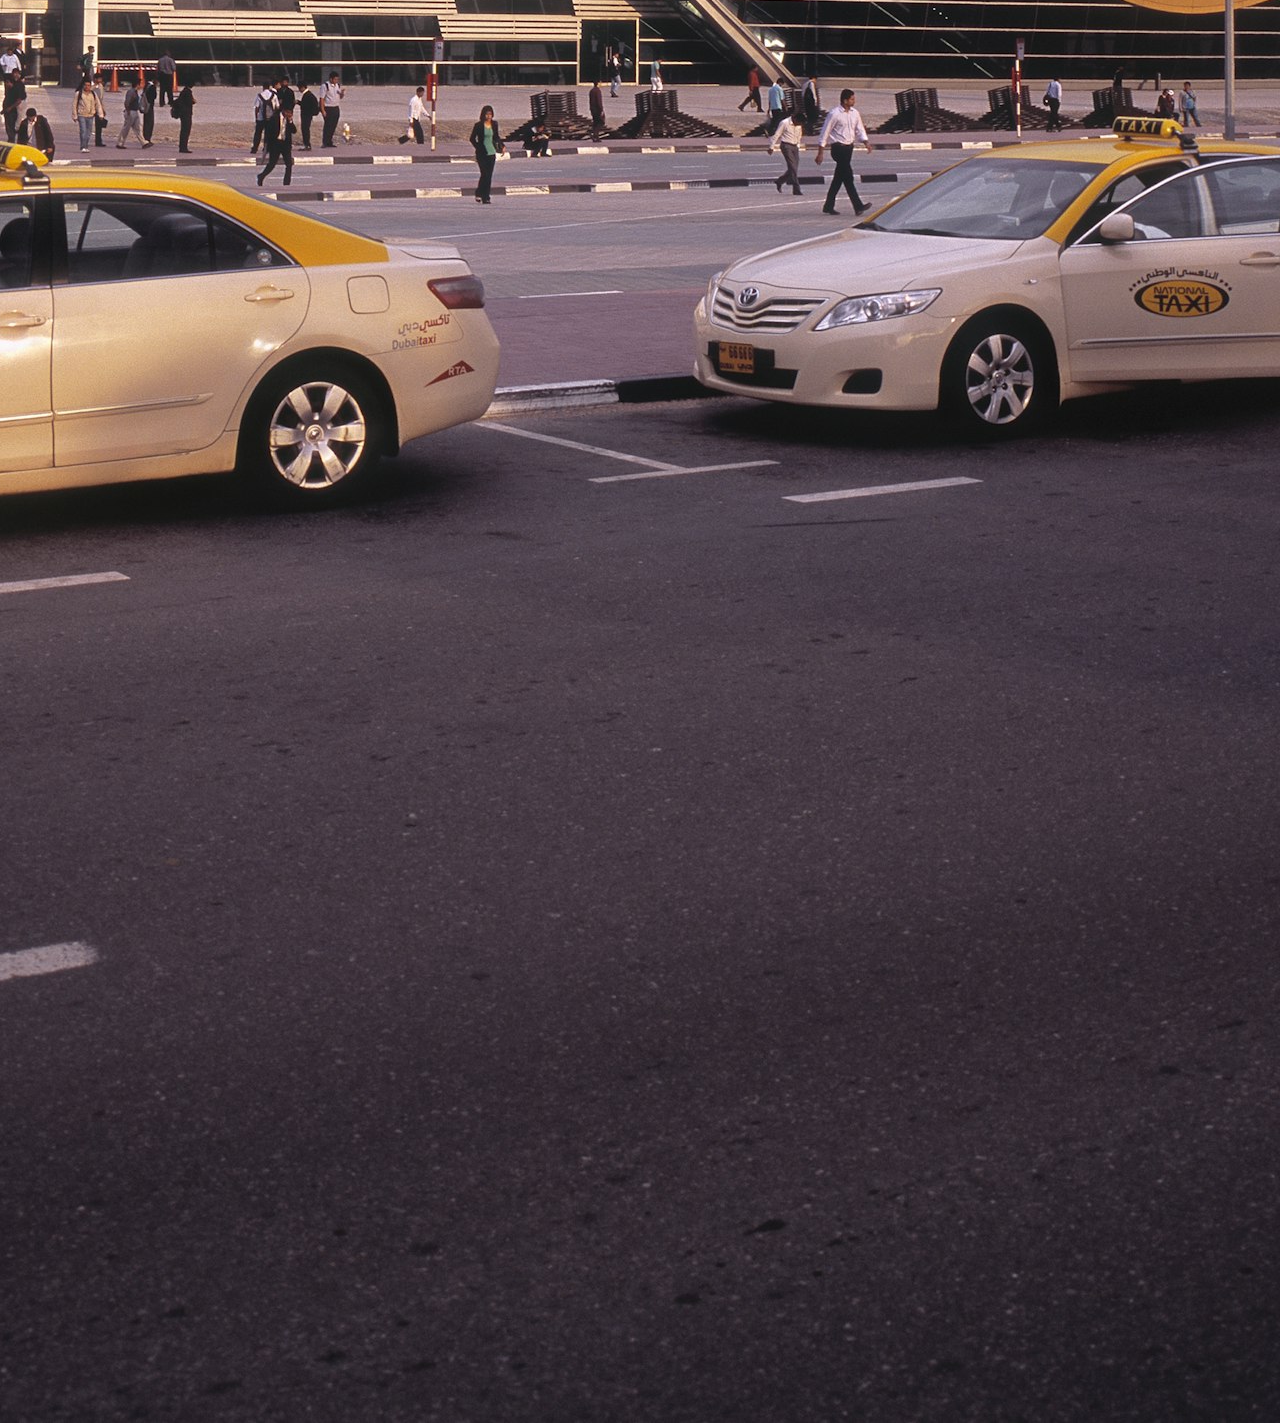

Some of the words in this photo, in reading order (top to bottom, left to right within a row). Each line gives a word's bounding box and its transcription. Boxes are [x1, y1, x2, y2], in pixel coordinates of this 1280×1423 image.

[1120, 119, 1157, 133] TAXI
[1154, 286, 1209, 295] NATIONAL
[1154, 294, 1210, 314] TAXI
[448, 366, 467, 376] RTA
